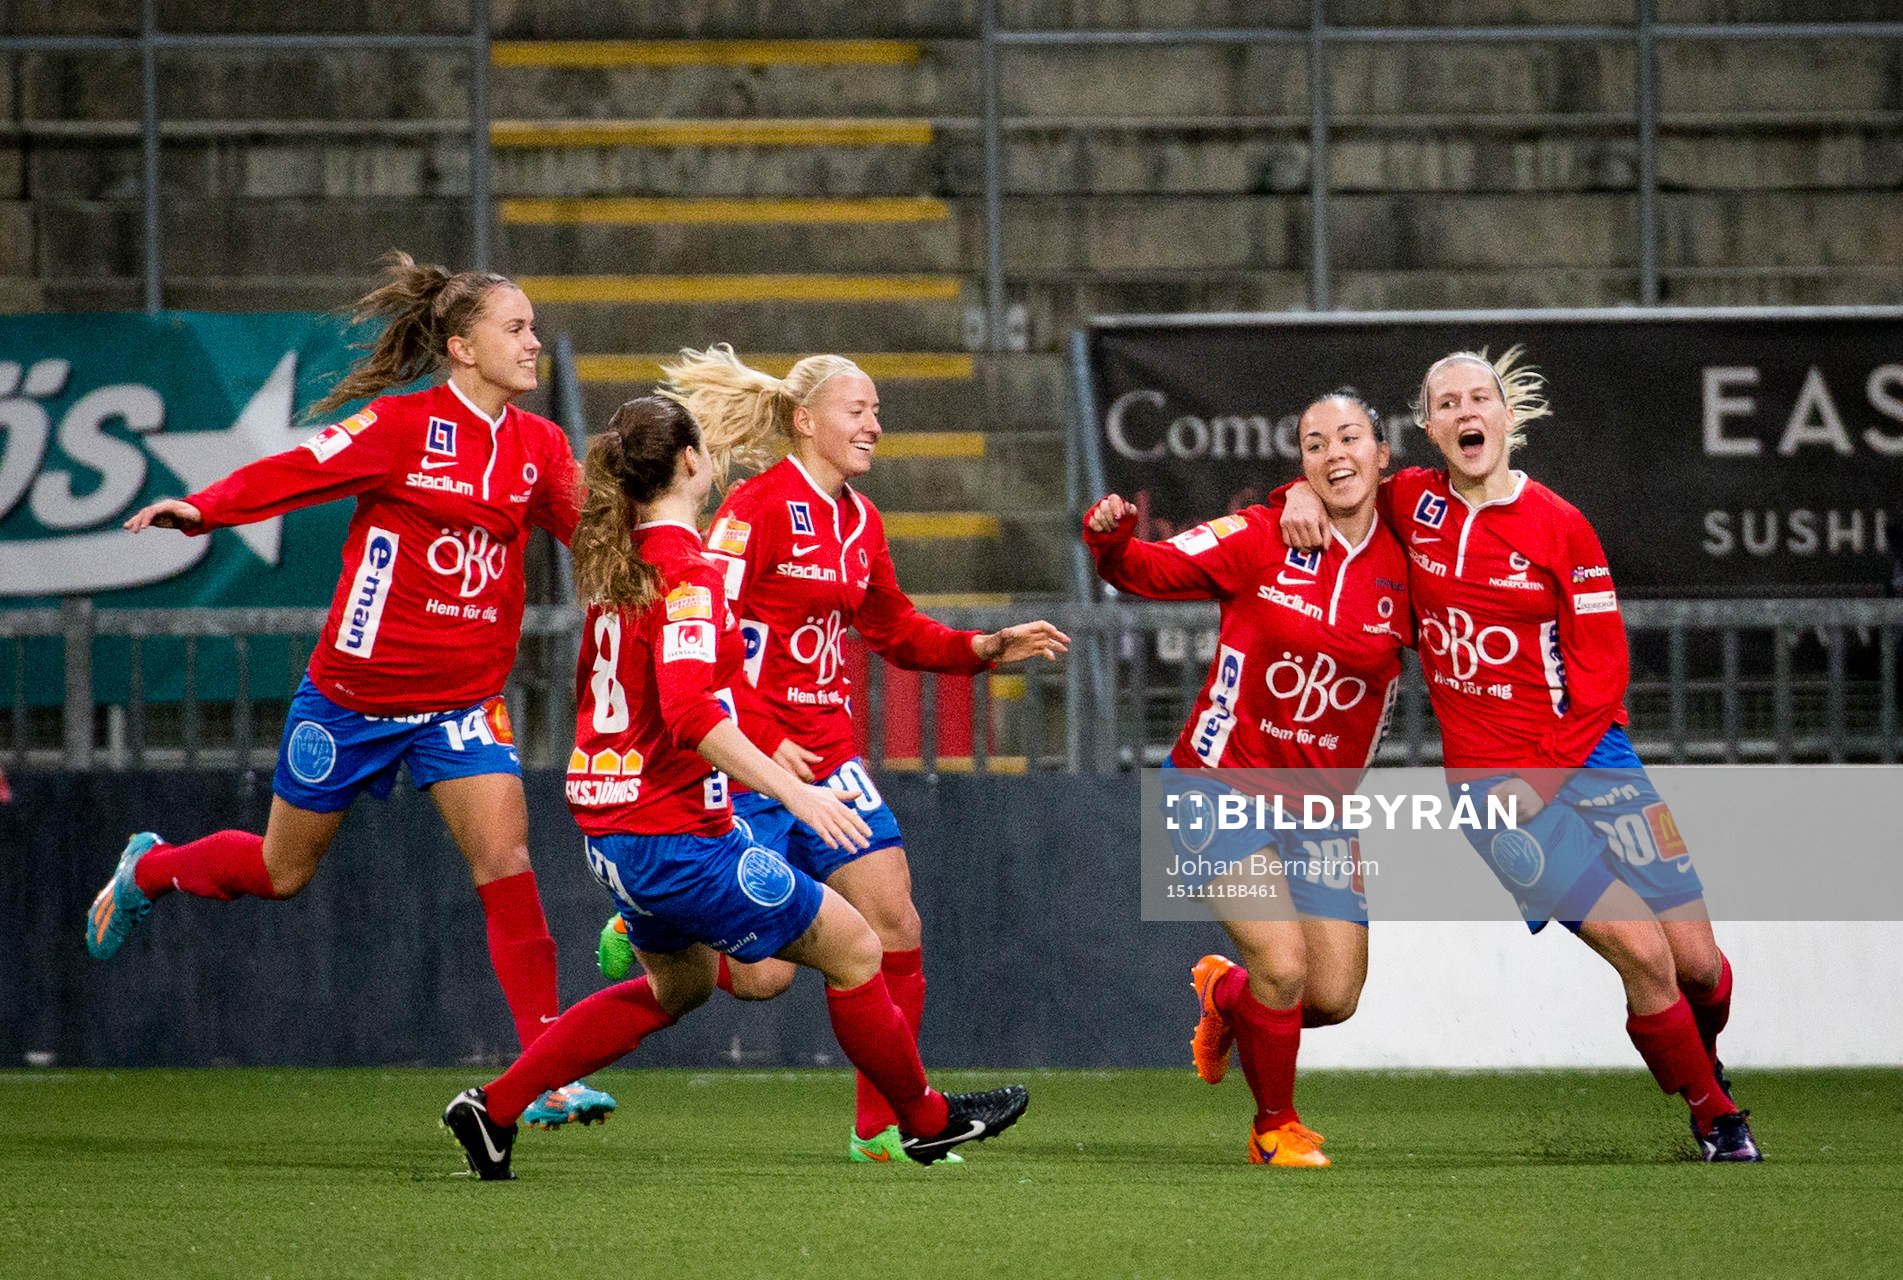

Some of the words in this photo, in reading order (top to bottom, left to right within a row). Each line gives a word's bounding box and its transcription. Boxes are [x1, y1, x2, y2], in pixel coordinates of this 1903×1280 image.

[1702, 364, 1903, 456] EAS
[406, 471, 474, 497] stadium
[1703, 509, 1889, 556] SUSHI
[427, 526, 507, 598] ÖBO
[776, 561, 837, 582] stadium
[345, 535, 393, 649] e-man
[426, 598, 460, 618] Hem
[463, 603, 481, 620] för
[482, 605, 498, 623] dig
[1257, 585, 1324, 622] stadium
[591, 612, 629, 734] 8
[1265, 652, 1367, 723] ÖBO
[1462, 682, 1484, 698] för
[1487, 683, 1513, 700] dig
[788, 686, 816, 705] Hem
[440, 709, 494, 751] 14
[1259, 718, 1293, 741] Hem
[1296, 728, 1316, 746] för
[1318, 733, 1340, 750] dig
